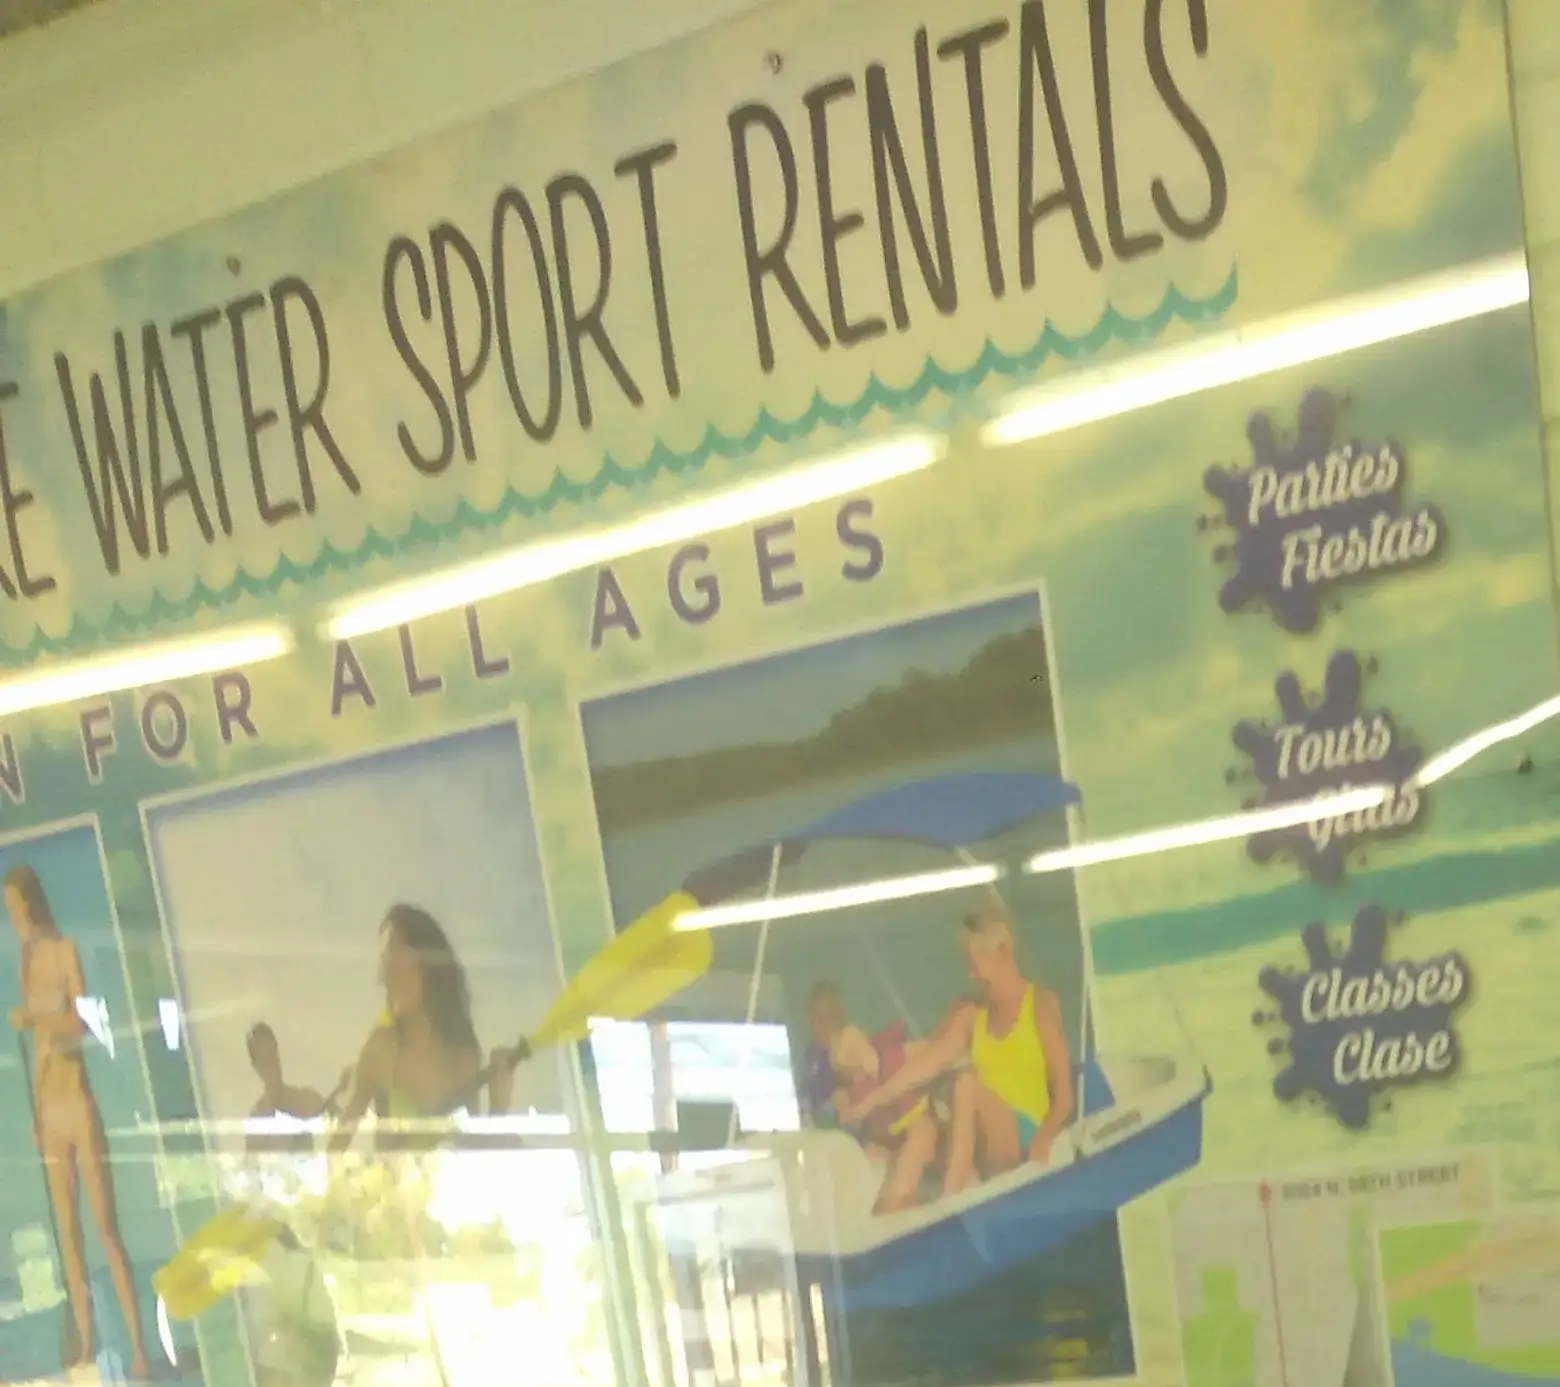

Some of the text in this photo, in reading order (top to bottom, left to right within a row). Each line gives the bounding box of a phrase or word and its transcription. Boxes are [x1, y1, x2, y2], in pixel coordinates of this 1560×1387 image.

[54, 275, 362, 576] WATER
[382, 138, 679, 476] SPORT
[727, 0, 1229, 374] RENTALS
[1247, 444, 1399, 525] Parties
[1281, 508, 1438, 588] Fiestas
[80, 671, 257, 777] FOR
[331, 603, 510, 717] ALL
[591, 499, 885, 650] AGES
[1275, 716, 1391, 779] Tours
[1301, 957, 1463, 1023] Classes
[1333, 1030, 1452, 1085] Clase
